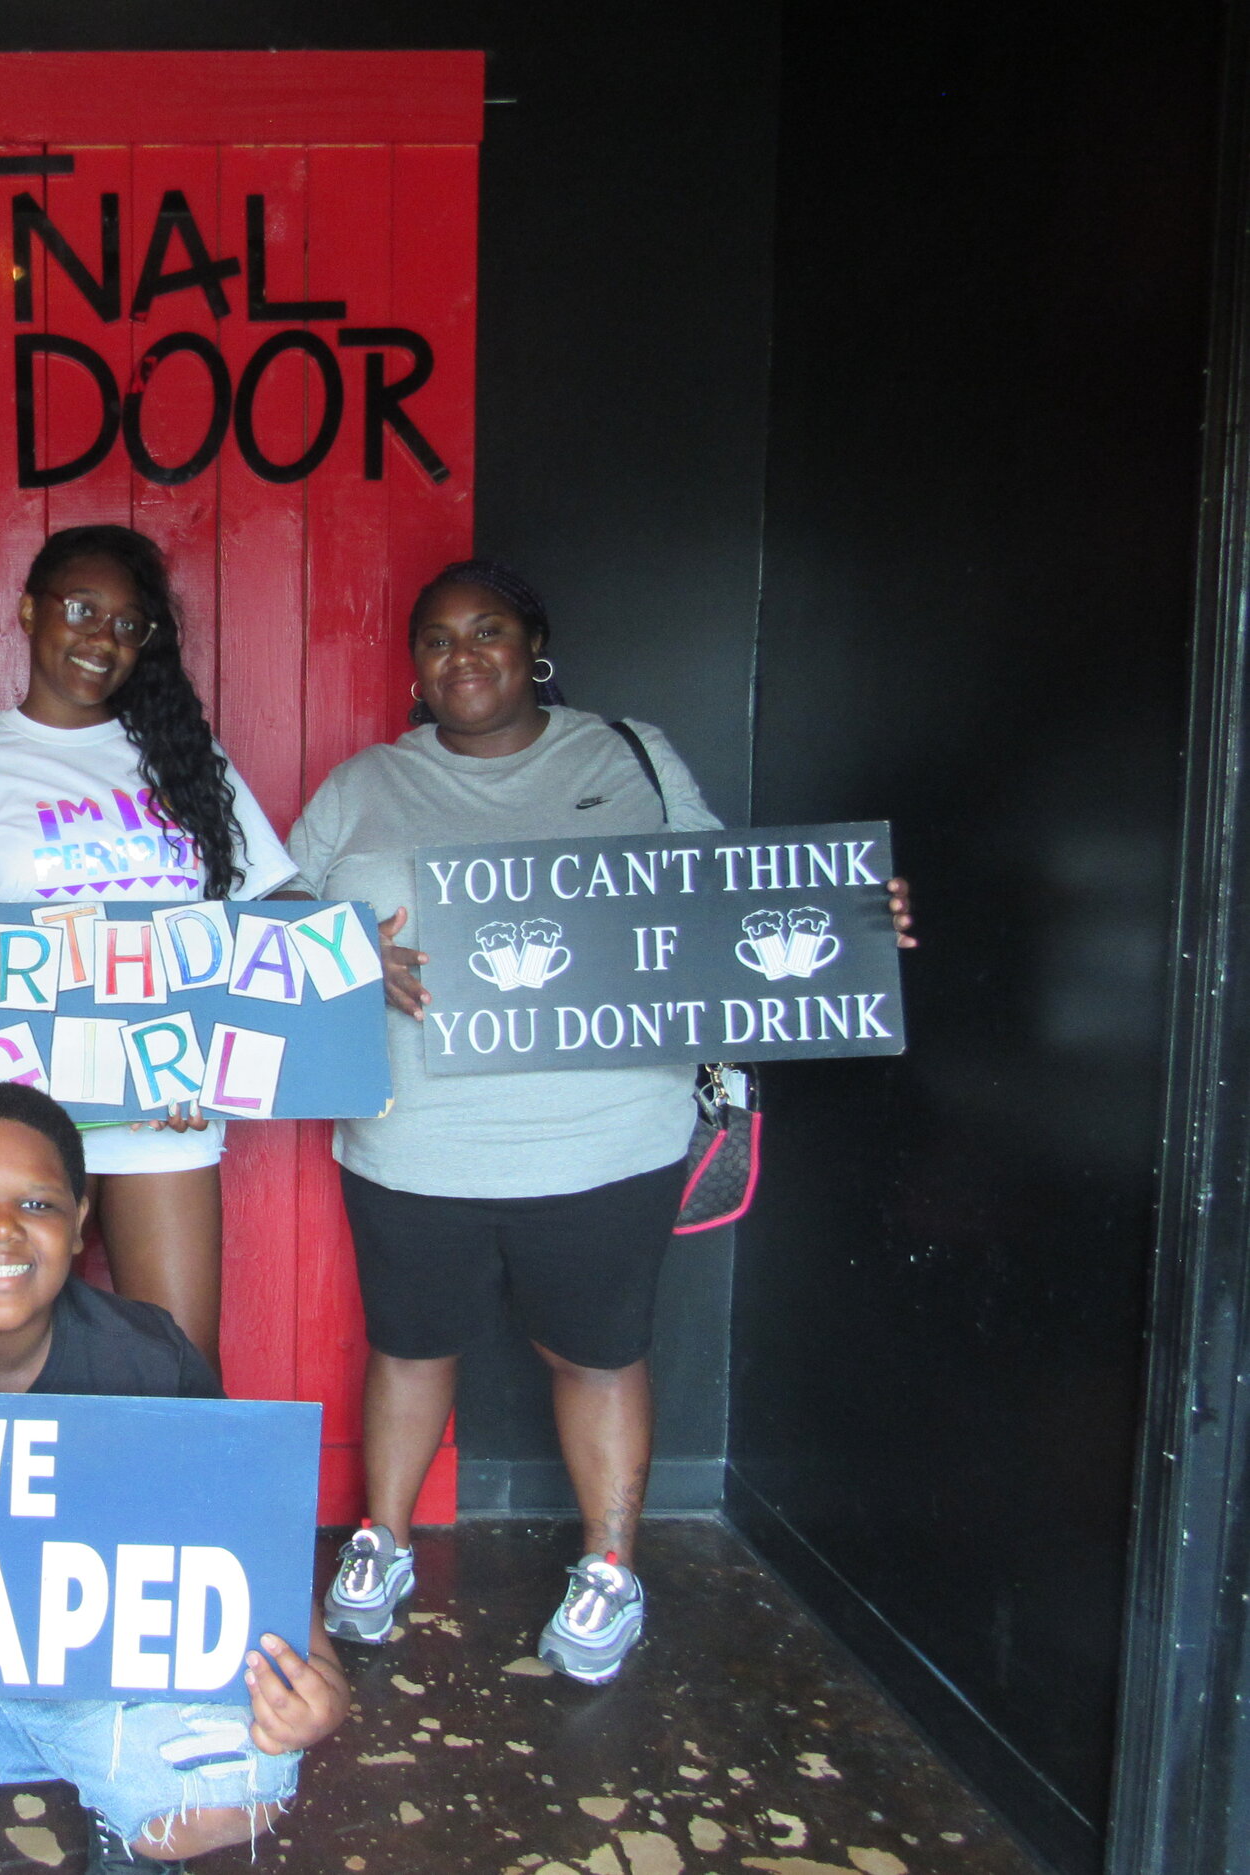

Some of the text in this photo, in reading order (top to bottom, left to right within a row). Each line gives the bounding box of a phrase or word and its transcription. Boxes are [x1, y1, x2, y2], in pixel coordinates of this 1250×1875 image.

[14, 326, 450, 489] DOOR
[426, 839, 882, 905] YOU CAN'T THINK
[633, 925, 679, 972] IF
[429, 992, 893, 1056] YOU DON'T DRINK
